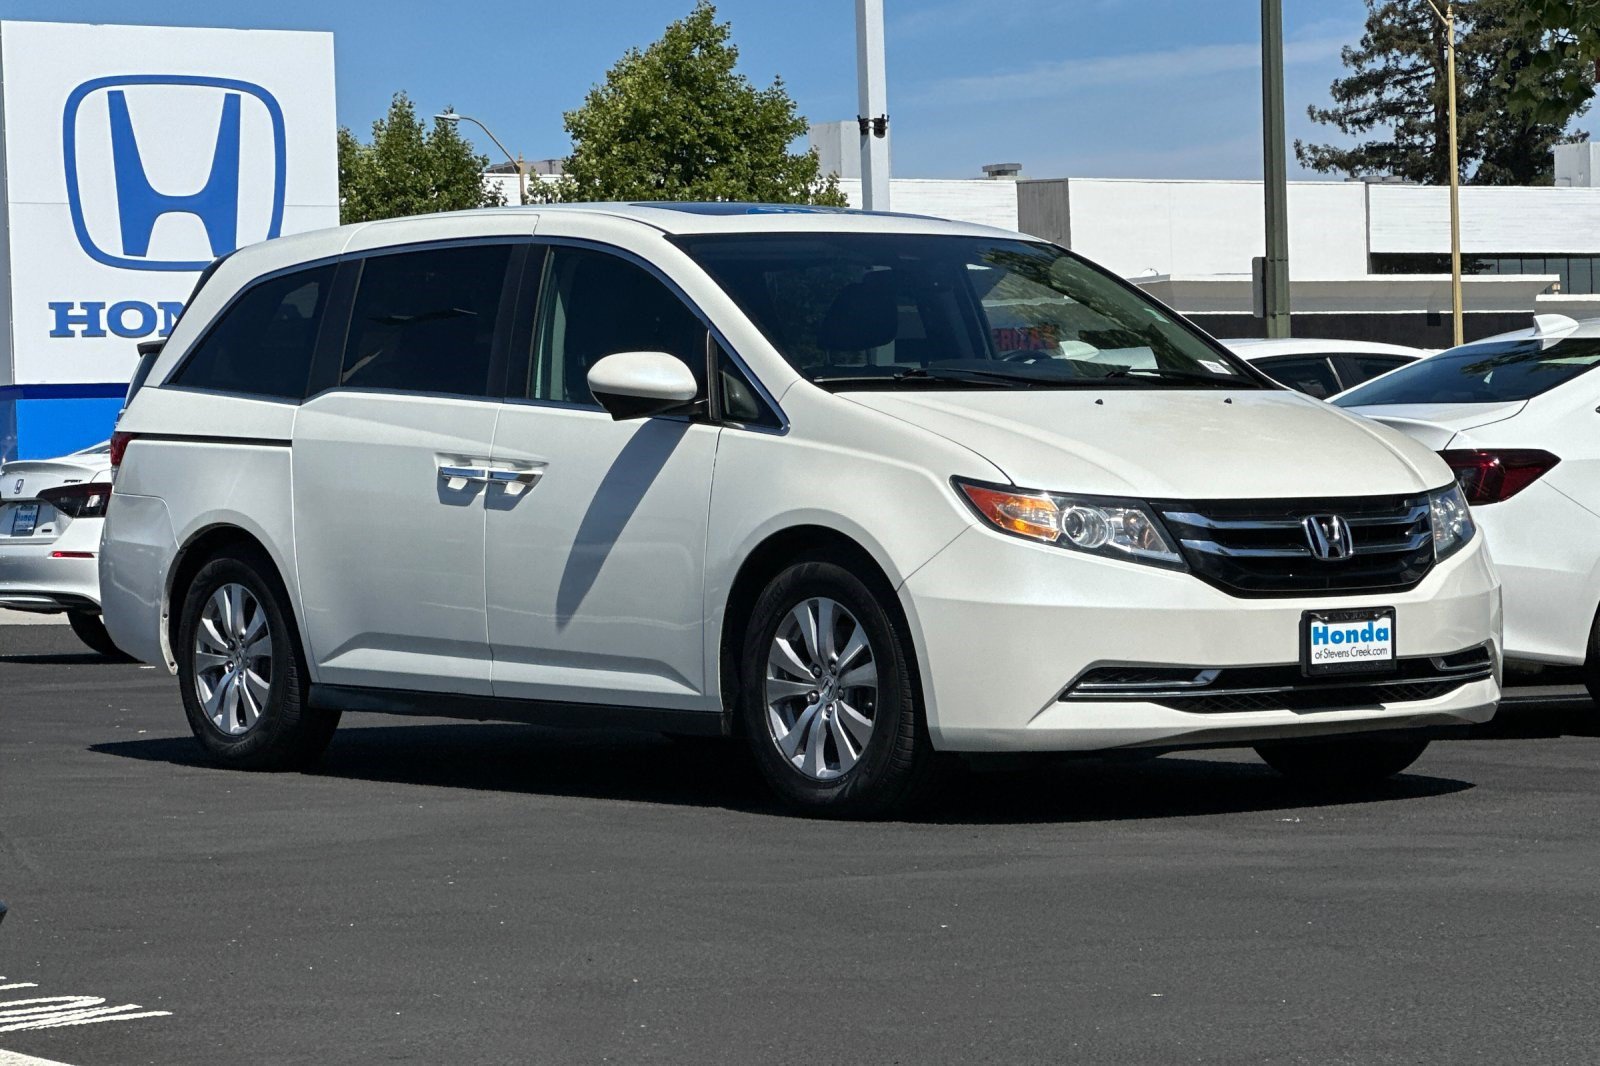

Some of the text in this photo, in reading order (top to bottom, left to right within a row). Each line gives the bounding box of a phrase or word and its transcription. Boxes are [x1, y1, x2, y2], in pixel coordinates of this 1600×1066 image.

[1312, 619, 1389, 645] Honda
[1314, 650, 1323, 659] of
[1323, 648, 1350, 659] Stevens
